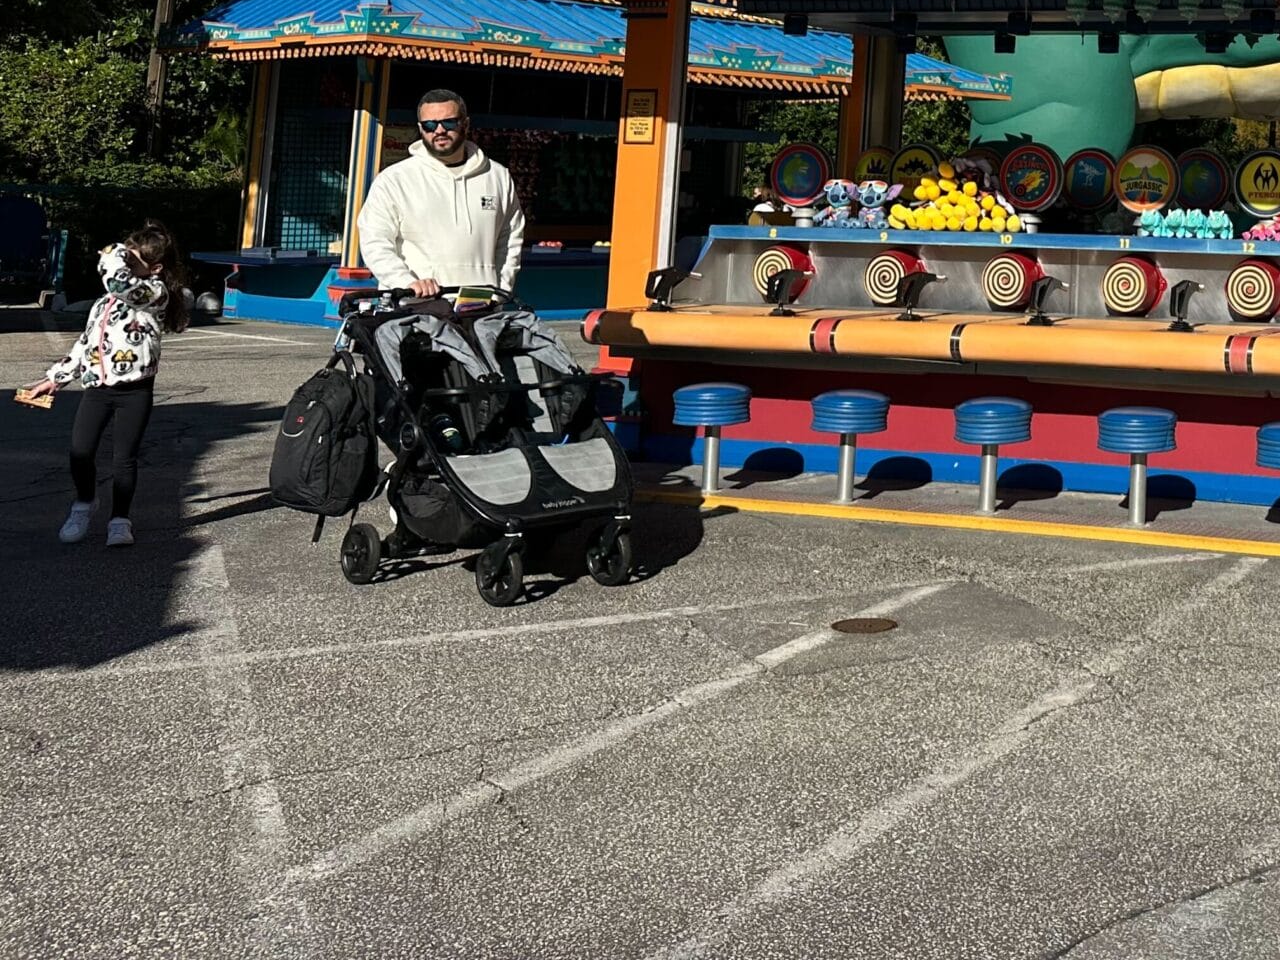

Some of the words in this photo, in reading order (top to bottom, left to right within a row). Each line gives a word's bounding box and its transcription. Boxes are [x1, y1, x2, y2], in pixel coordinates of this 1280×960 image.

[1124, 180, 1163, 193] JURGASSIC
[769, 227, 778, 238] 8
[879, 231, 888, 242] 9
[1000, 234, 1013, 245] 10
[1119, 238, 1130, 249] 11
[1242, 242, 1256, 253] 12
